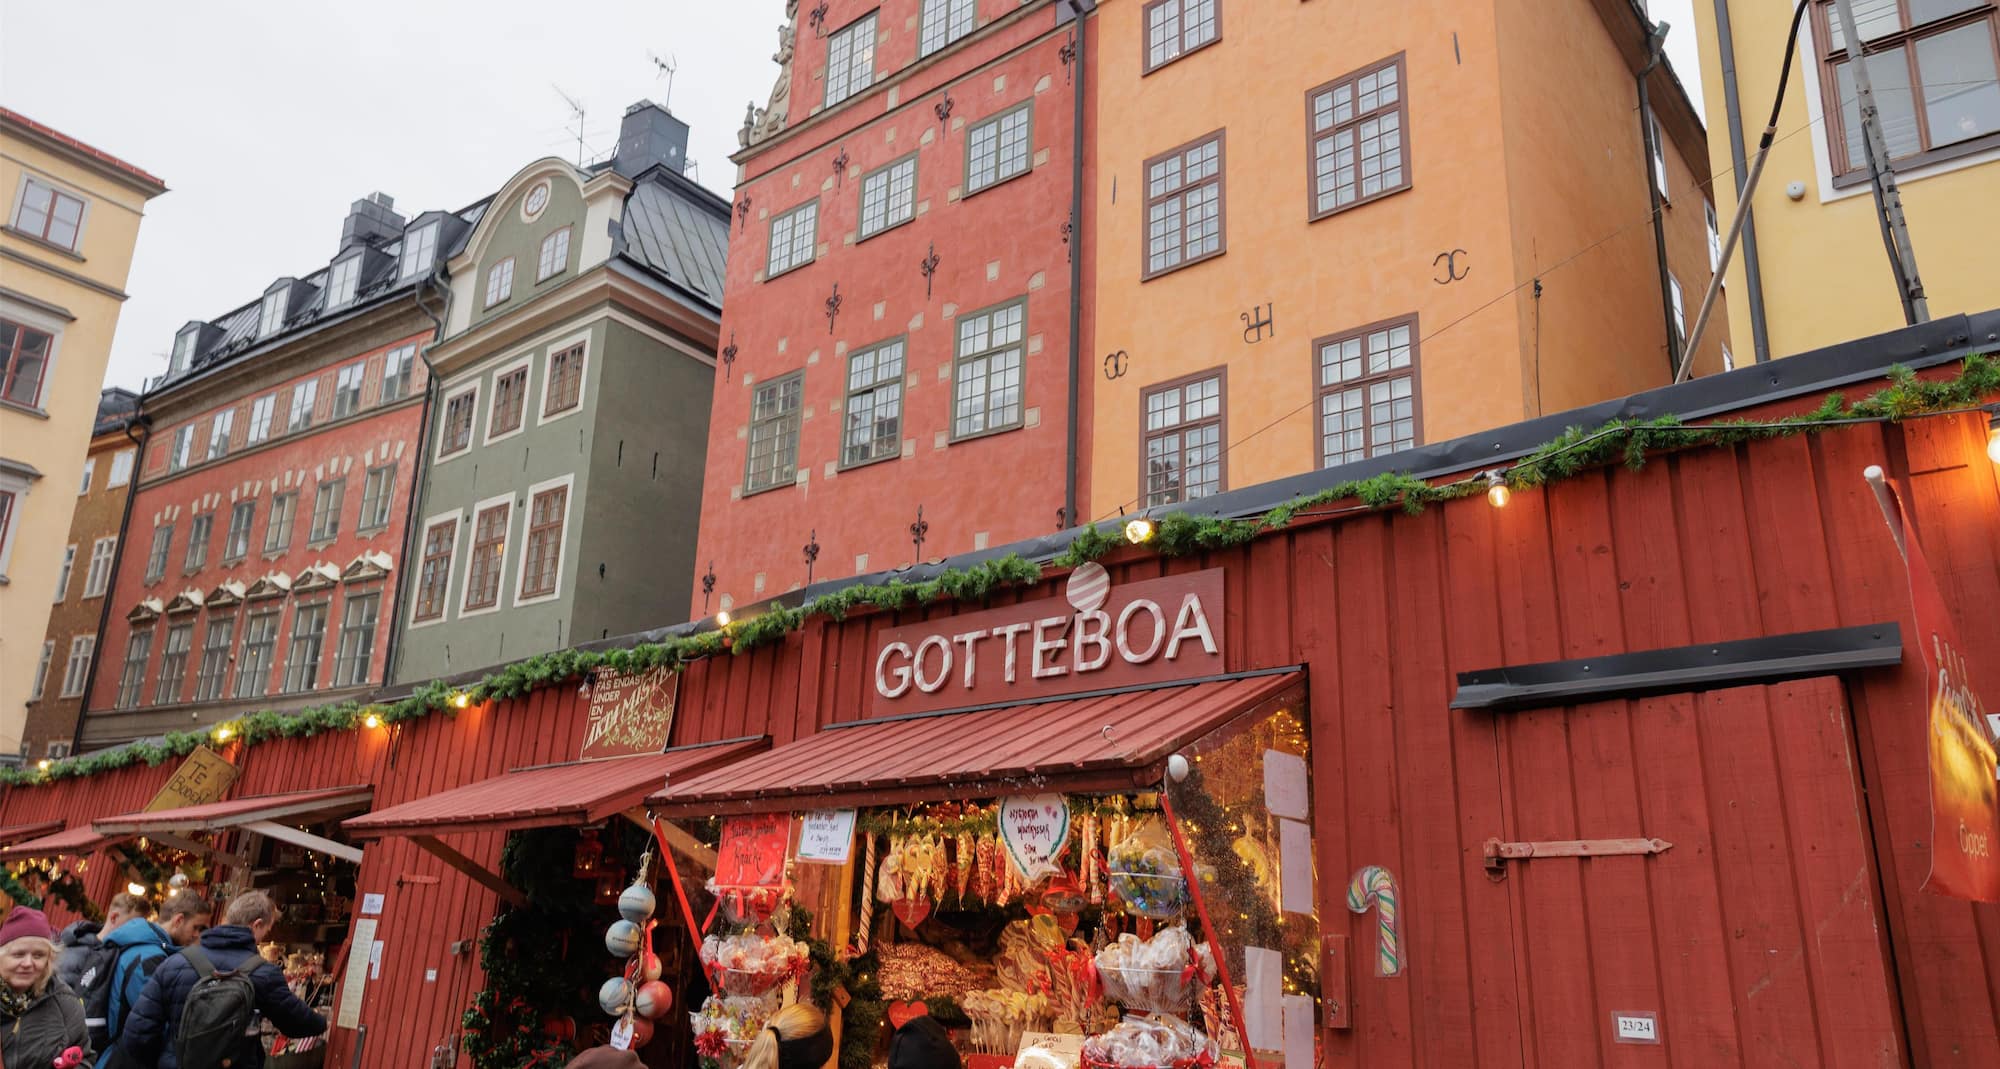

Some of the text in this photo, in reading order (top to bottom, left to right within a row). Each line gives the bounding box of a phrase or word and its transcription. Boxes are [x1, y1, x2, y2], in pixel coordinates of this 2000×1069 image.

[875, 593, 1218, 698] GOTTEBOA
[593, 690, 620, 704] UNDER
[591, 704, 604, 716] EN
[1622, 1020, 1650, 1032] 23/24
